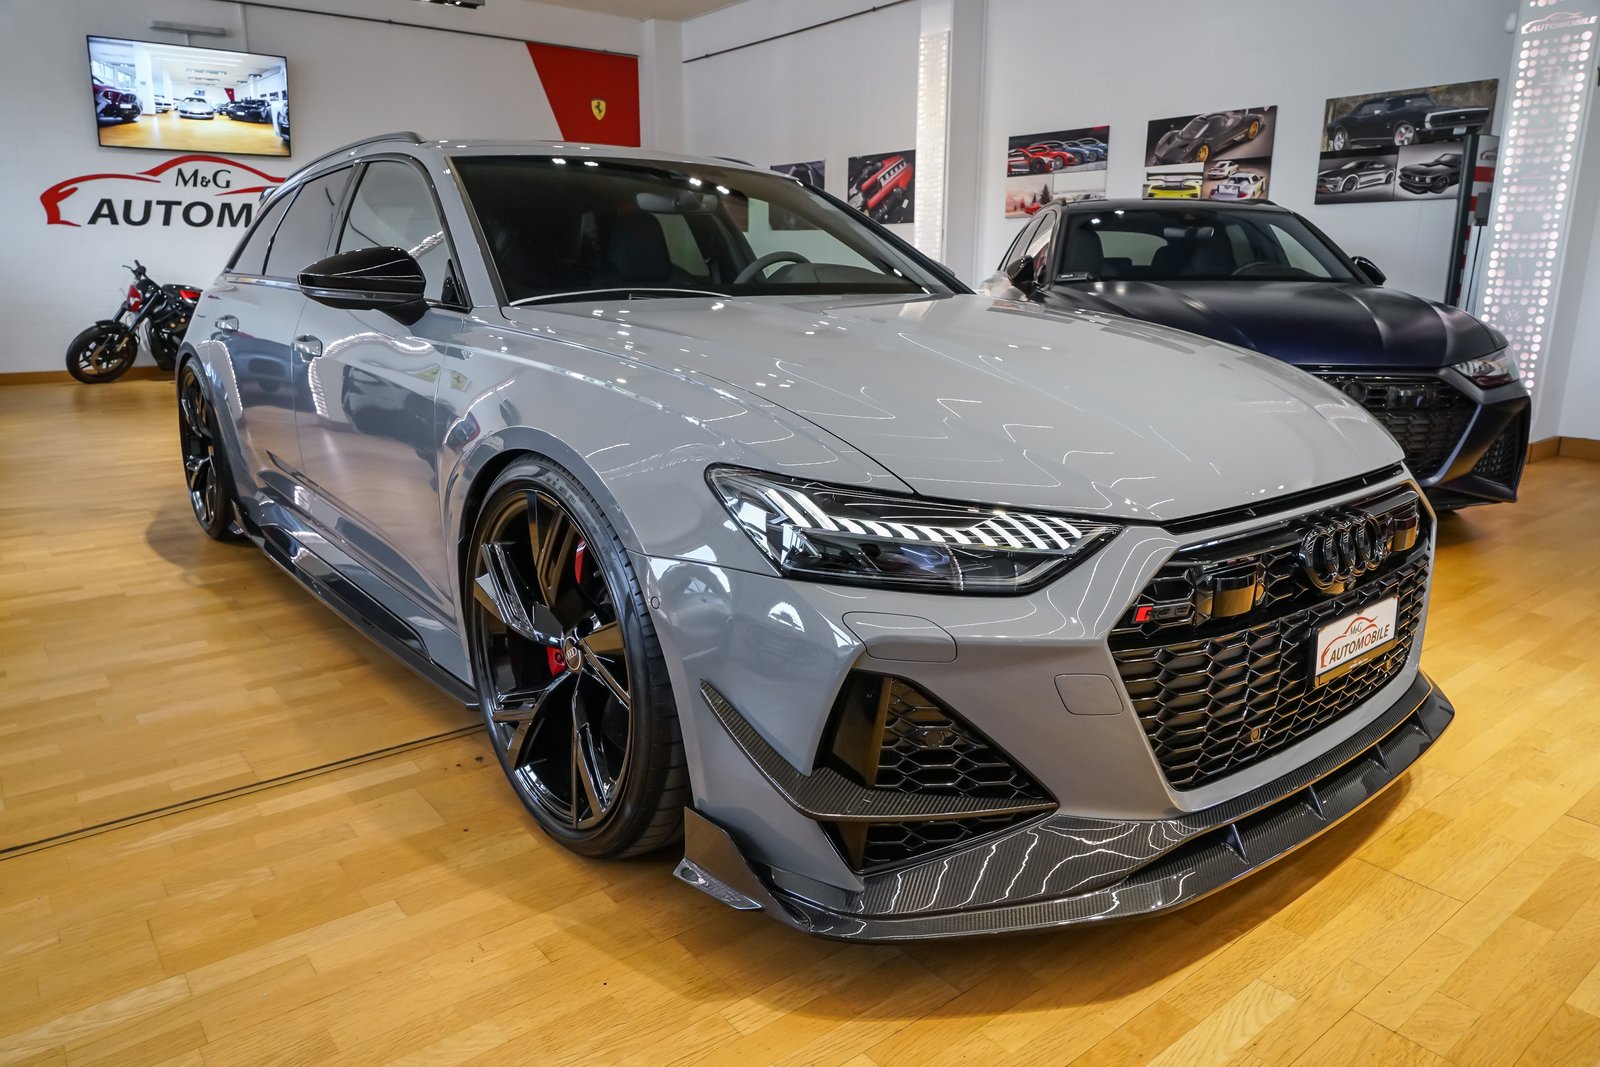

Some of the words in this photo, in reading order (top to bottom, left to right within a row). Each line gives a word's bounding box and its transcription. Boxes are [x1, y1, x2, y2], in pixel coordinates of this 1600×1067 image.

[175, 167, 232, 189] M&G
[87, 197, 253, 229] AUTOM
[1328, 623, 1390, 665] AUTOMOBILE
